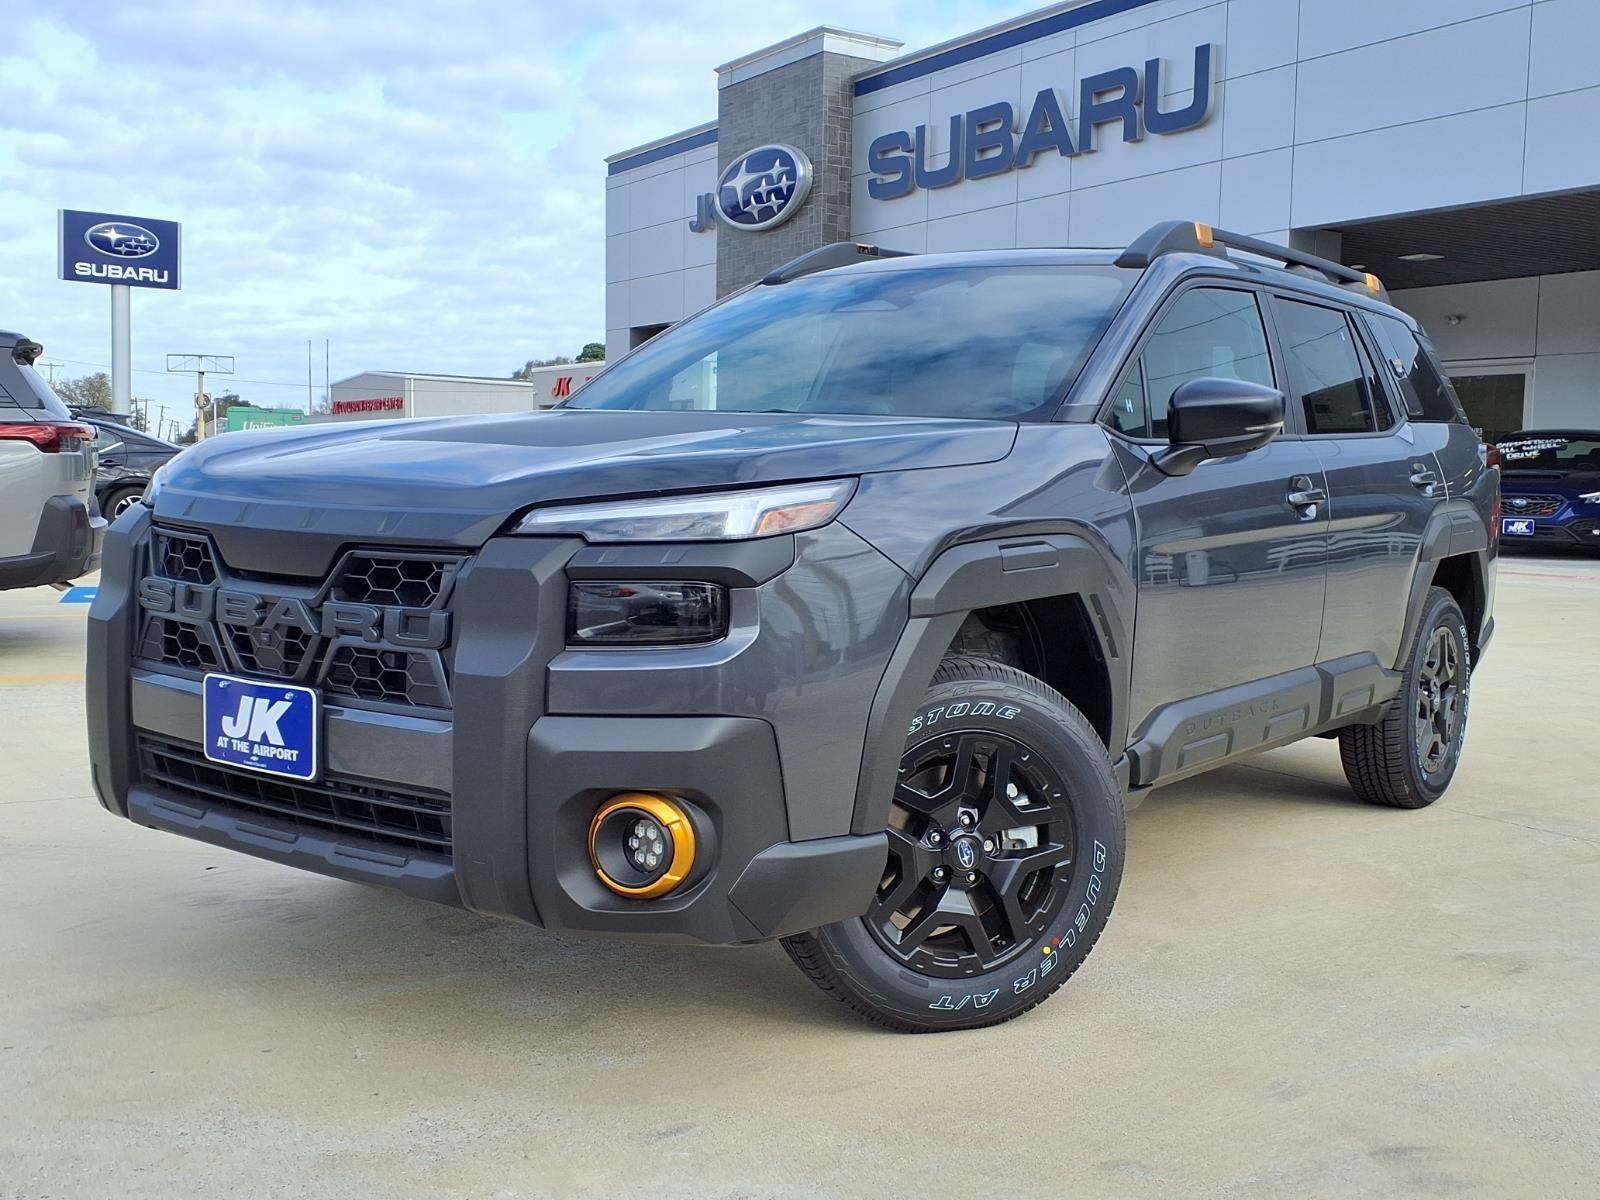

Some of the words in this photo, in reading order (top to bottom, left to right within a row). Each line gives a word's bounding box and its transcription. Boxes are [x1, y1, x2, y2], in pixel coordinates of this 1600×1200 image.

[867, 43, 1216, 200] SUBARU
[689, 192, 716, 233] JK
[75, 262, 168, 283] SUBARU
[552, 376, 572, 397] JK
[1506, 450, 1541, 460] DRIVE
[140, 576, 451, 648] SUBARU
[222, 695, 292, 746] JK
[1186, 700, 1280, 734] OUTBACK
[217, 736, 229, 748] AT
[231, 739, 249, 753] THE
[253, 744, 298, 761] AIRPORT
[1014, 840, 1106, 995] DUELER
[929, 989, 999, 1010] A/T
